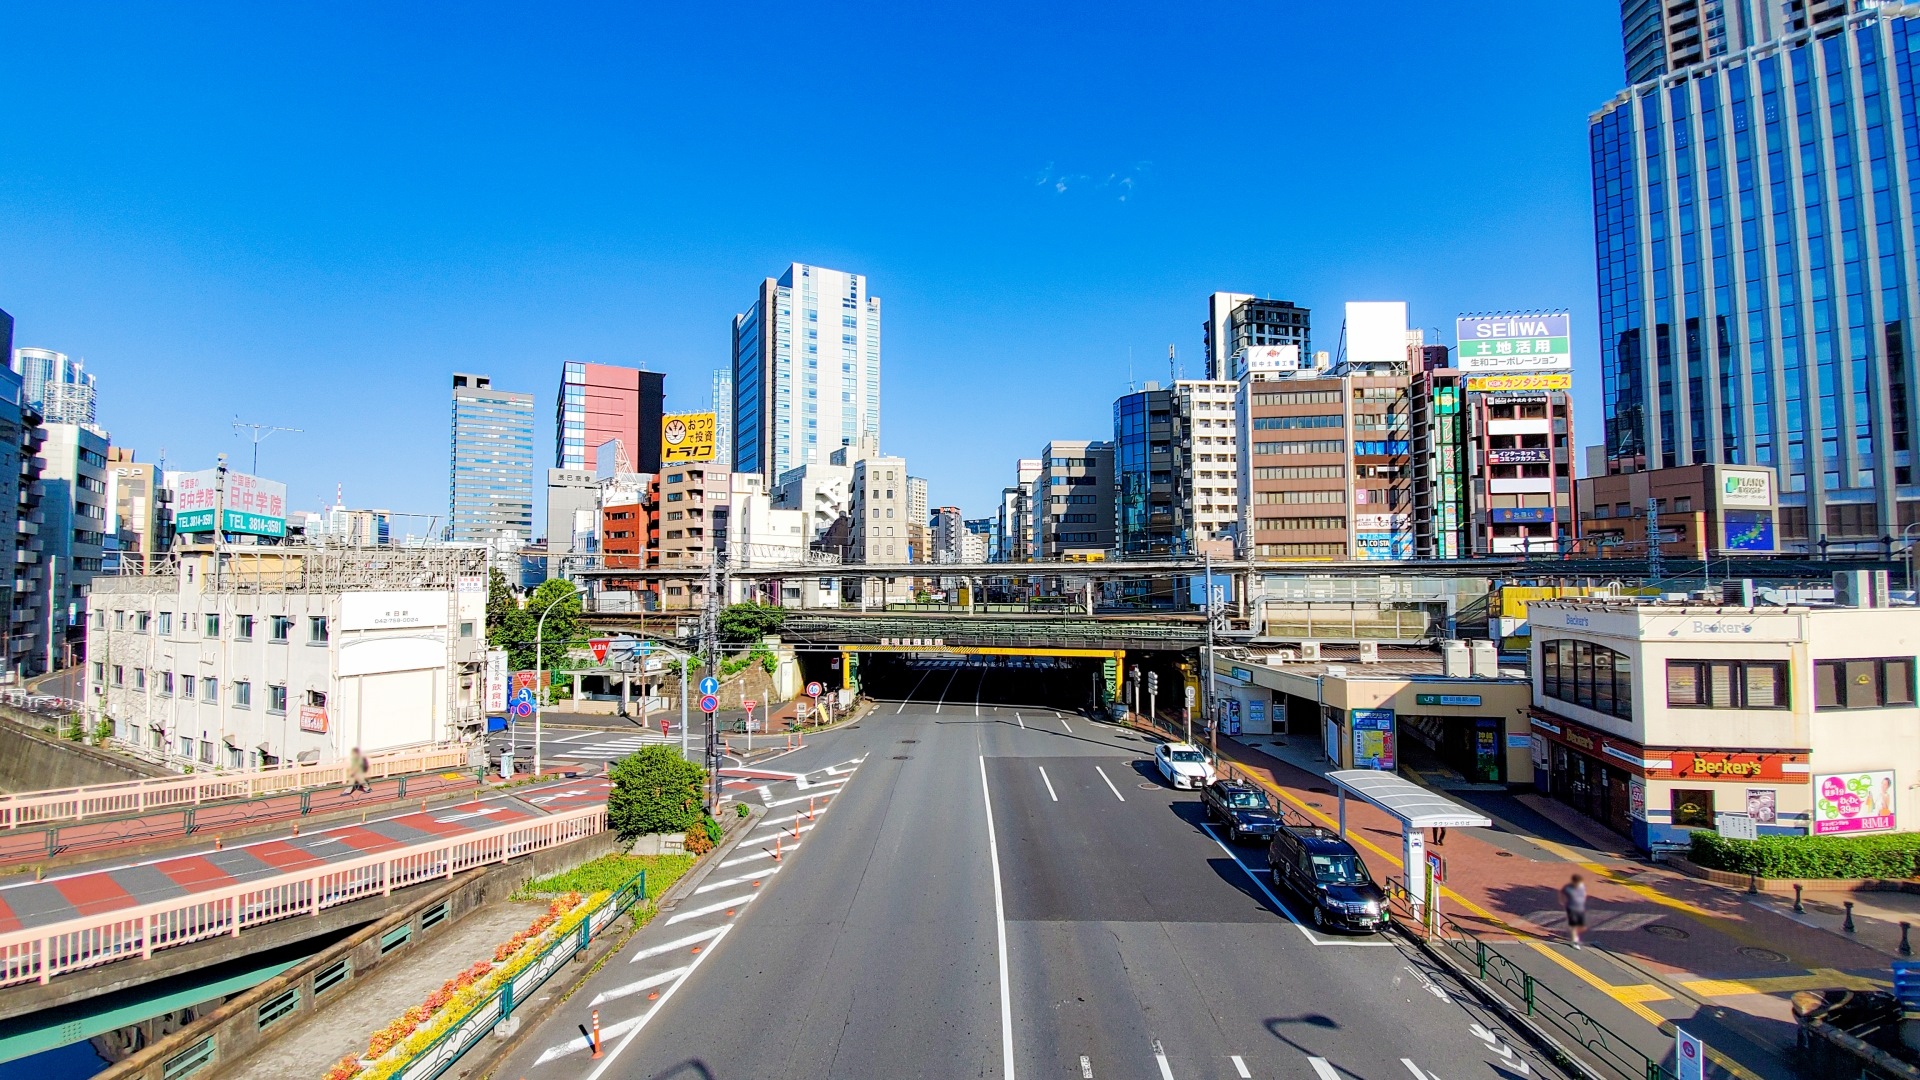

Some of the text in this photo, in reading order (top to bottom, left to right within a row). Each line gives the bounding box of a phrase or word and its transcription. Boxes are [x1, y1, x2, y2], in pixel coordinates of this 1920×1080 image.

[1476, 340, 1551, 355] 土地活用
[1470, 356, 1558, 367] 生和コーポレーション
[687, 418, 713, 431] おつり
[687, 430, 713, 443] で投資
[665, 445, 712, 458] トラノコ
[231, 473, 257, 489] 中国語の
[180, 487, 214, 509] 日中学院
[230, 486, 282, 517] 日中学院
[178, 516, 190, 528] TEL
[229, 513, 282, 534] TEL 3814-3591
[1566, 614, 1589, 627] Becker's
[1692, 620, 1752, 634] Becker's
[491, 684, 502, 709] 飲食街
[1693, 758, 1761, 775] Becker's
[1840, 796, 1859, 804] わくわく
